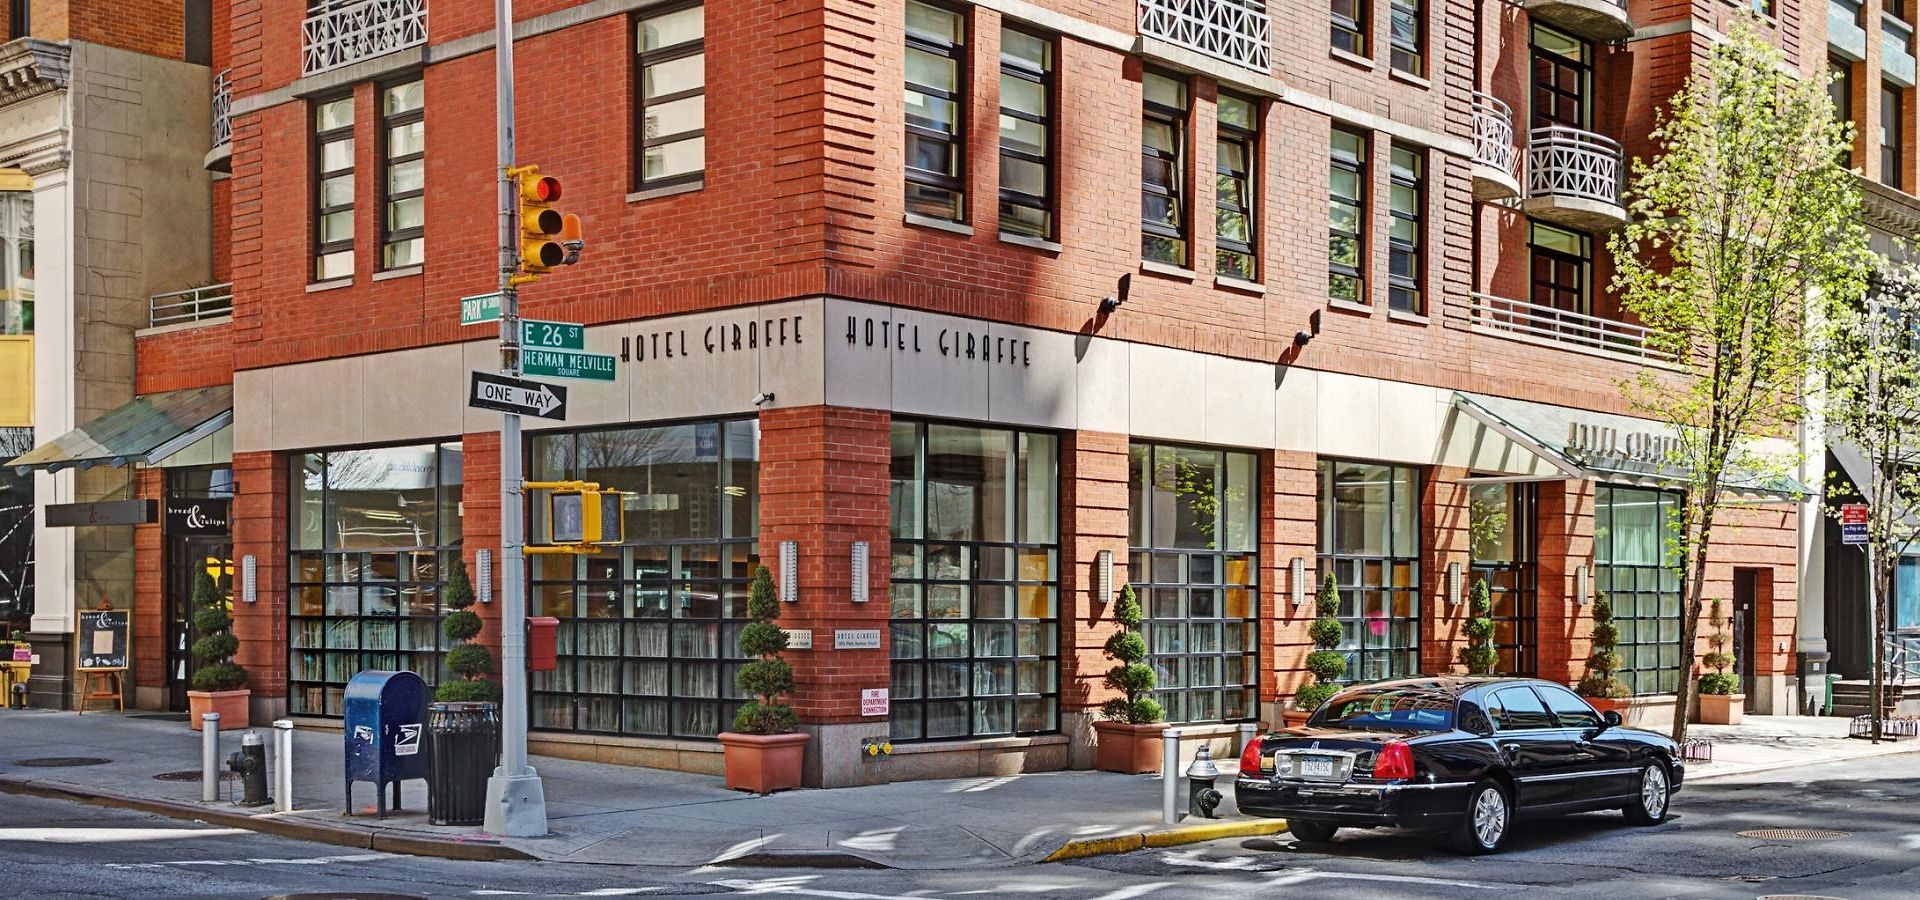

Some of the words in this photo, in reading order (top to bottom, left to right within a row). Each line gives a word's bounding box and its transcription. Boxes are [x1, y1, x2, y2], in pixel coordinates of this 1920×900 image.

[463, 299, 481, 321] PARK
[525, 323, 535, 344] E
[542, 325, 563, 346] 26
[569, 327, 579, 338] ST
[620, 330, 687, 362] HOTEL
[704, 316, 802, 354] GIRAFFE
[846, 316, 921, 352] HOTEL
[939, 328, 1030, 366] GIRAFFE
[524, 350, 564, 368] HERMAN
[569, 356, 613, 372] MELVILLE
[557, 367, 581, 377] SQUARE
[485, 384, 513, 402] ONE
[524, 391, 553, 408] WAY
[186, 504, 206, 528] &
[201, 518, 225, 527] tulips
[863, 697, 887, 706] DEPARTMENT
[863, 706, 887, 714] CONNECTION
